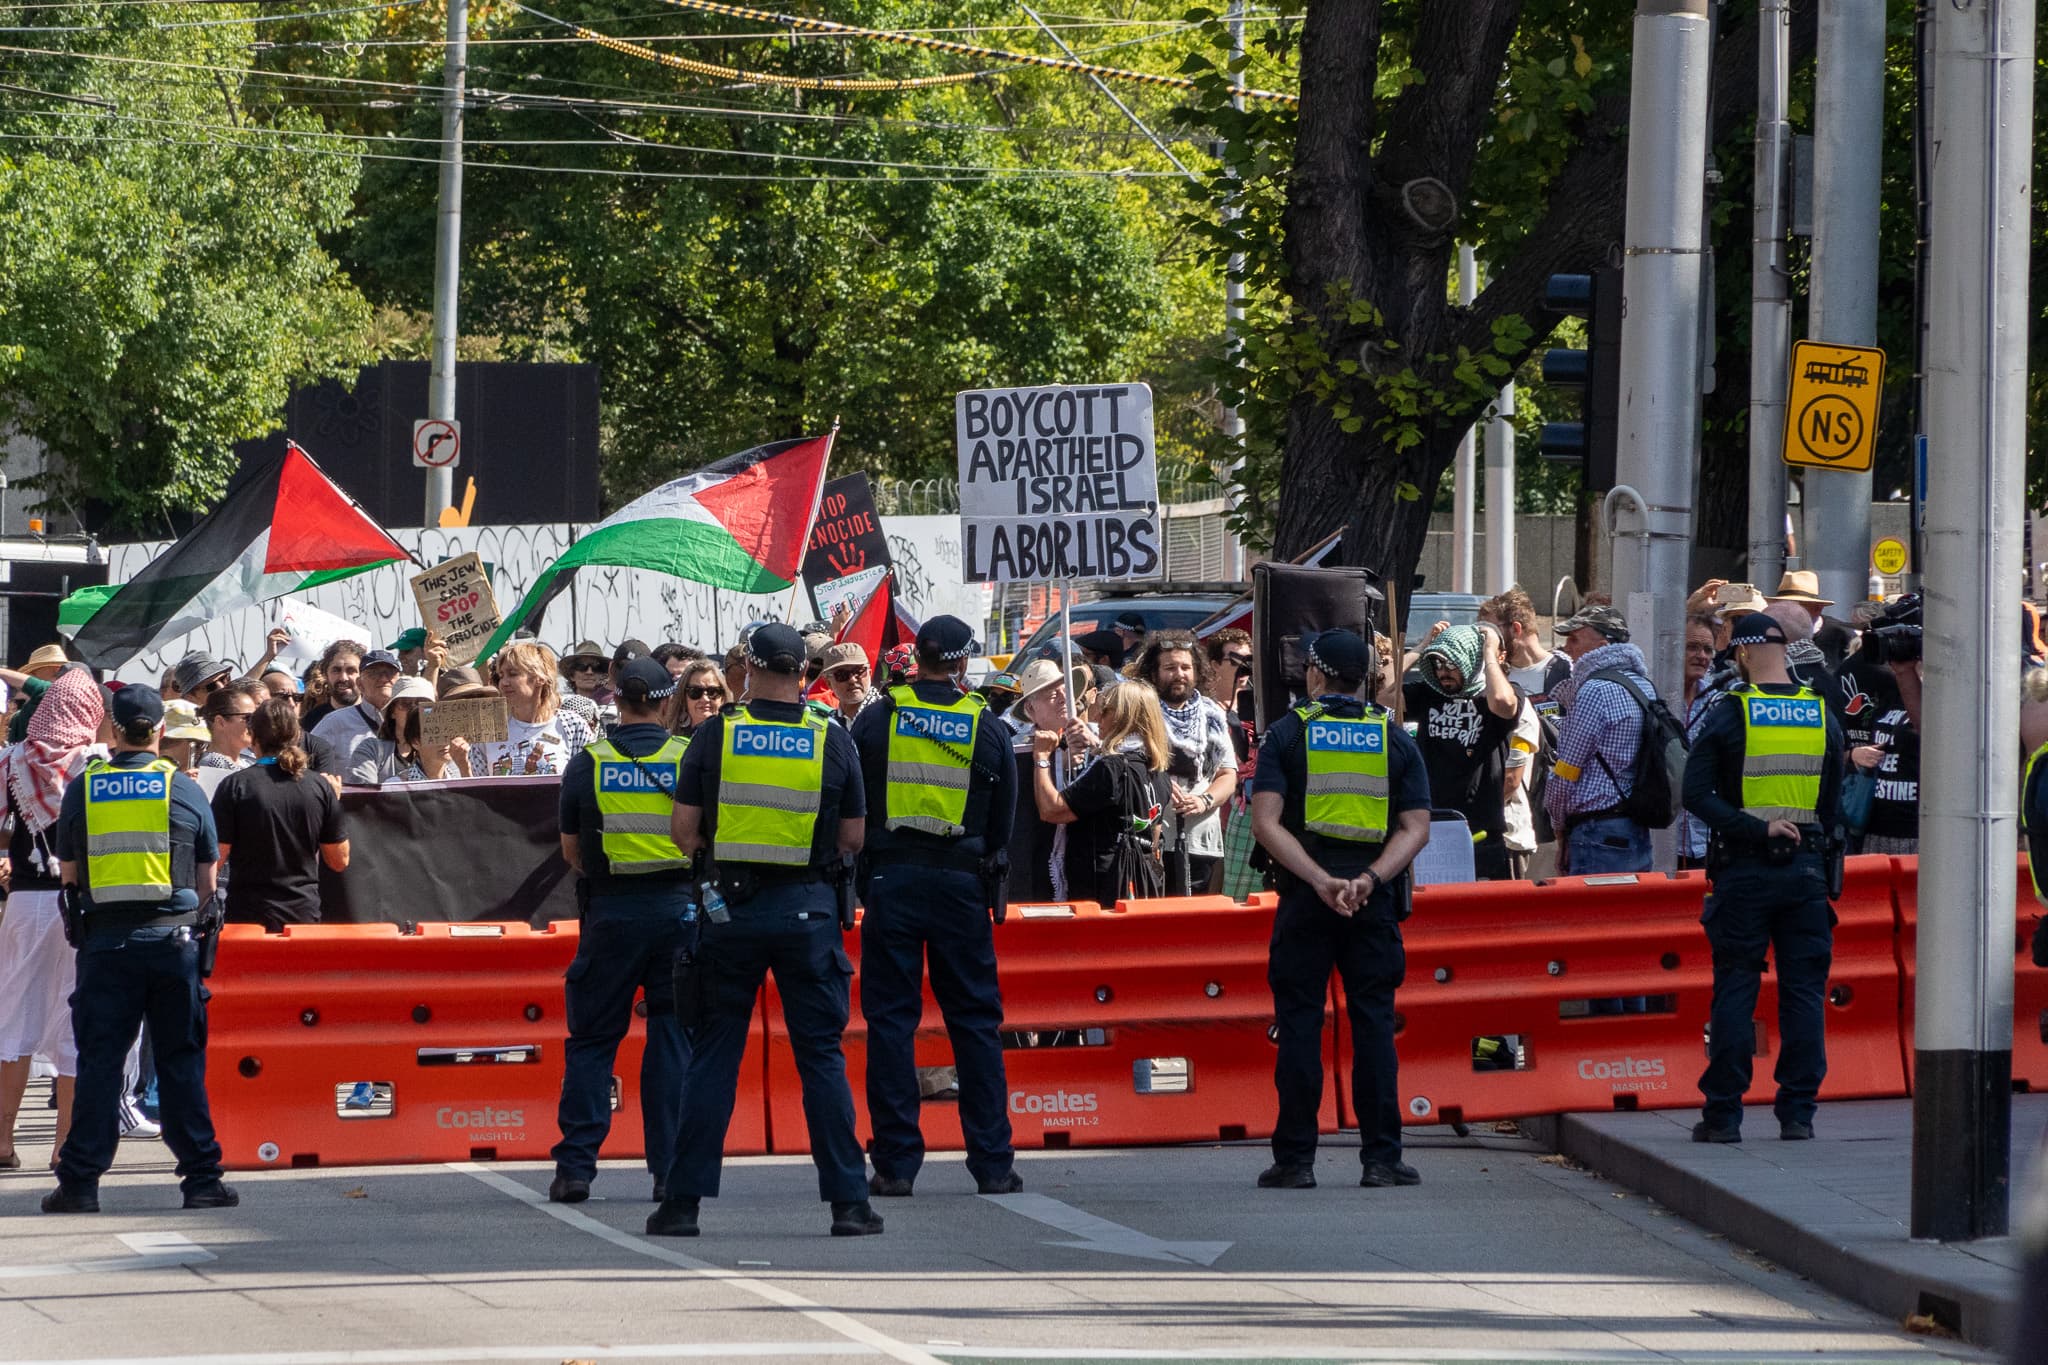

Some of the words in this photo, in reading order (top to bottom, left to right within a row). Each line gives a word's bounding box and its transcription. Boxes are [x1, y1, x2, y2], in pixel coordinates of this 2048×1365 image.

[965, 387, 1128, 439] BOYCOTT
[1811, 410, 1852, 445] NS
[967, 433, 1145, 483] APARTHEID
[1017, 472, 1158, 520] ISRAEL,
[807, 511, 875, 551] ENOCIDE
[419, 575, 447, 593] THIS
[448, 562, 476, 582] JEW
[439, 581, 469, 602] SAYS
[437, 592, 479, 622] STOP
[820, 600, 842, 619] FRE
[448, 612, 475, 630] THE
[1752, 702, 1819, 721] Police
[900, 711, 969, 738] Police
[737, 730, 811, 753] Police
[1312, 726, 1379, 747] Police
[93, 776, 163, 797] Police
[604, 767, 673, 787] Police
[1578, 1056, 1665, 1080] Coates
[1612, 1082, 1643, 1092] MASH
[1010, 1089, 1098, 1114] Coates
[437, 1106, 525, 1129] Coates
[1043, 1117, 1074, 1127] MASH
[469, 1132, 500, 1142] MASH
